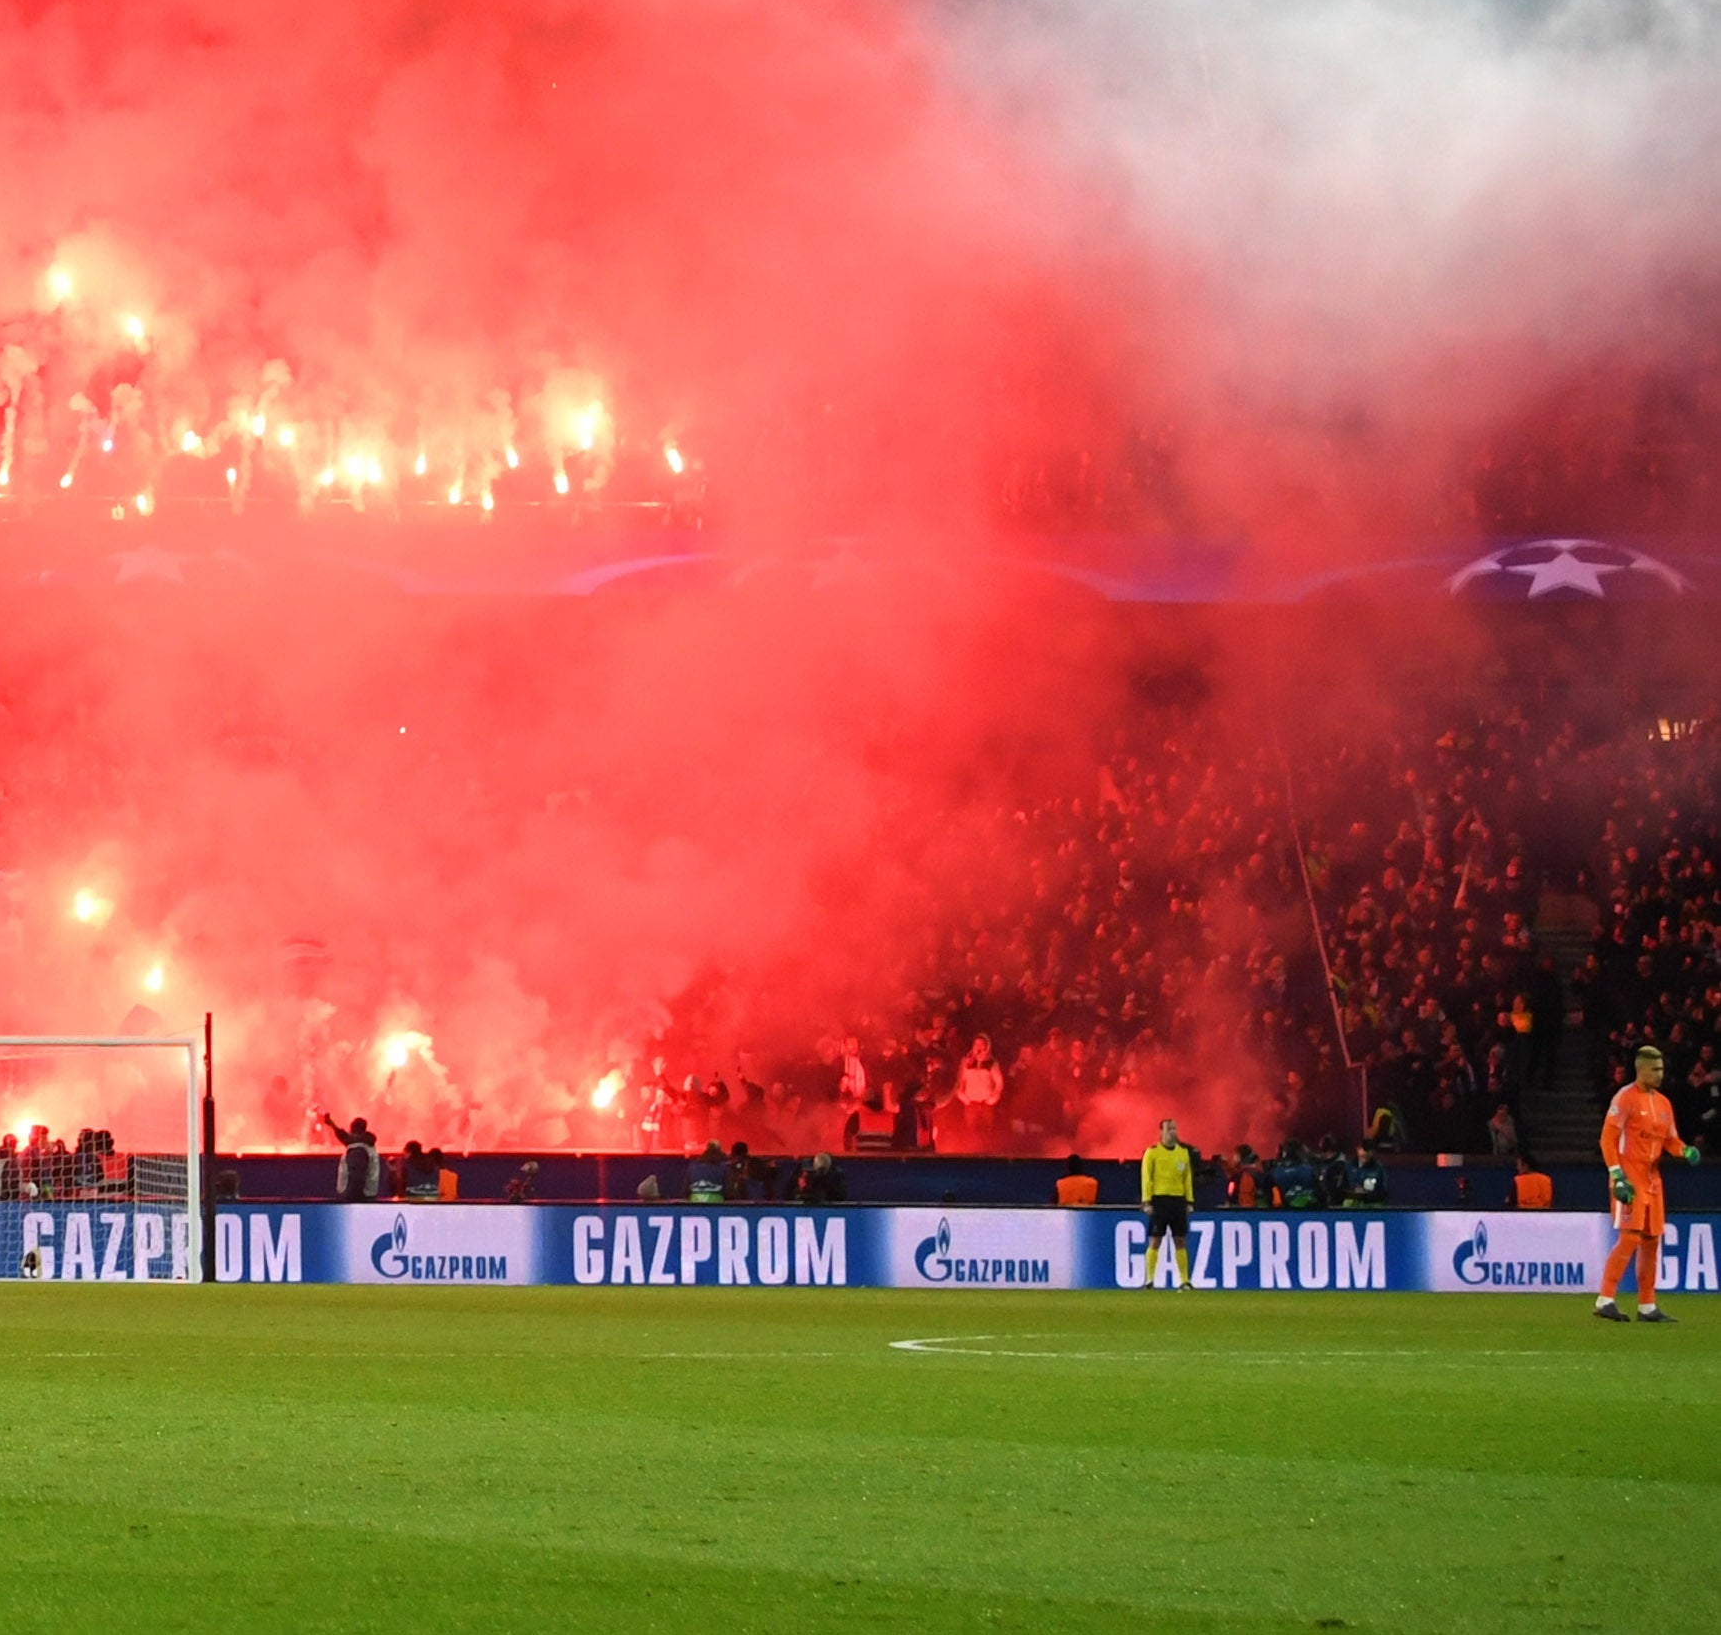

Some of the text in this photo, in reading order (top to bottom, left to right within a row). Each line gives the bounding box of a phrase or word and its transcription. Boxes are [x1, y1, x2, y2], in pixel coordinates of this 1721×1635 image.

[574, 1216, 846, 1284] GAZPROM
[1115, 1221, 1386, 1289] GAZPROM
[412, 1256, 507, 1280] GAZPROM
[955, 1259, 1050, 1283] GAZPROM
[1492, 1262, 1585, 1285] GAZPROM
